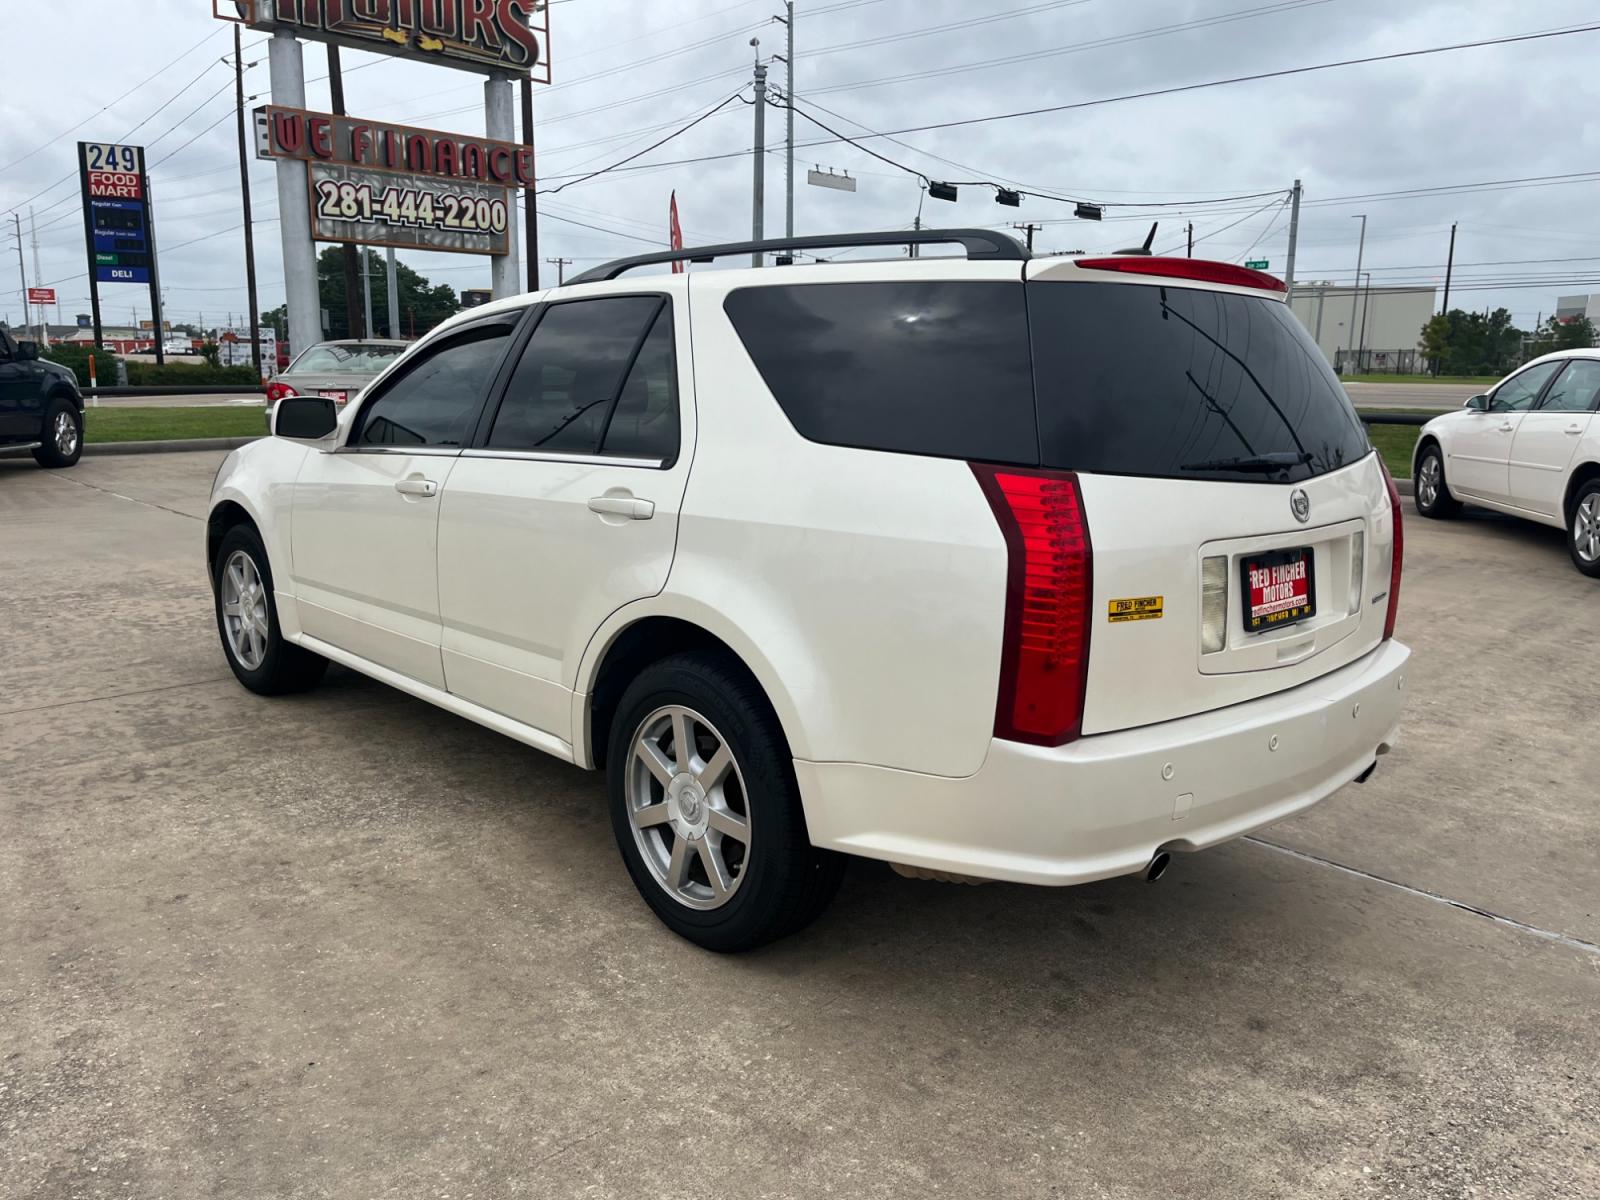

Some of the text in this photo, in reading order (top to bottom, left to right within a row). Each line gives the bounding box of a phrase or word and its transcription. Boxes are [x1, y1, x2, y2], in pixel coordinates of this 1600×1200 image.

[274, 112, 536, 186] WE FINANCE
[89, 145, 135, 172] 249
[91, 173, 137, 186] FOOD
[91, 184, 138, 198] MART
[91, 200, 111, 208] Regular
[319, 180, 507, 232] 281-444-2200
[94, 229, 115, 237] Regular
[111, 269, 133, 279] DELI
[1271, 560, 1306, 585] FINCHER
[1263, 581, 1294, 603] MOTORS
